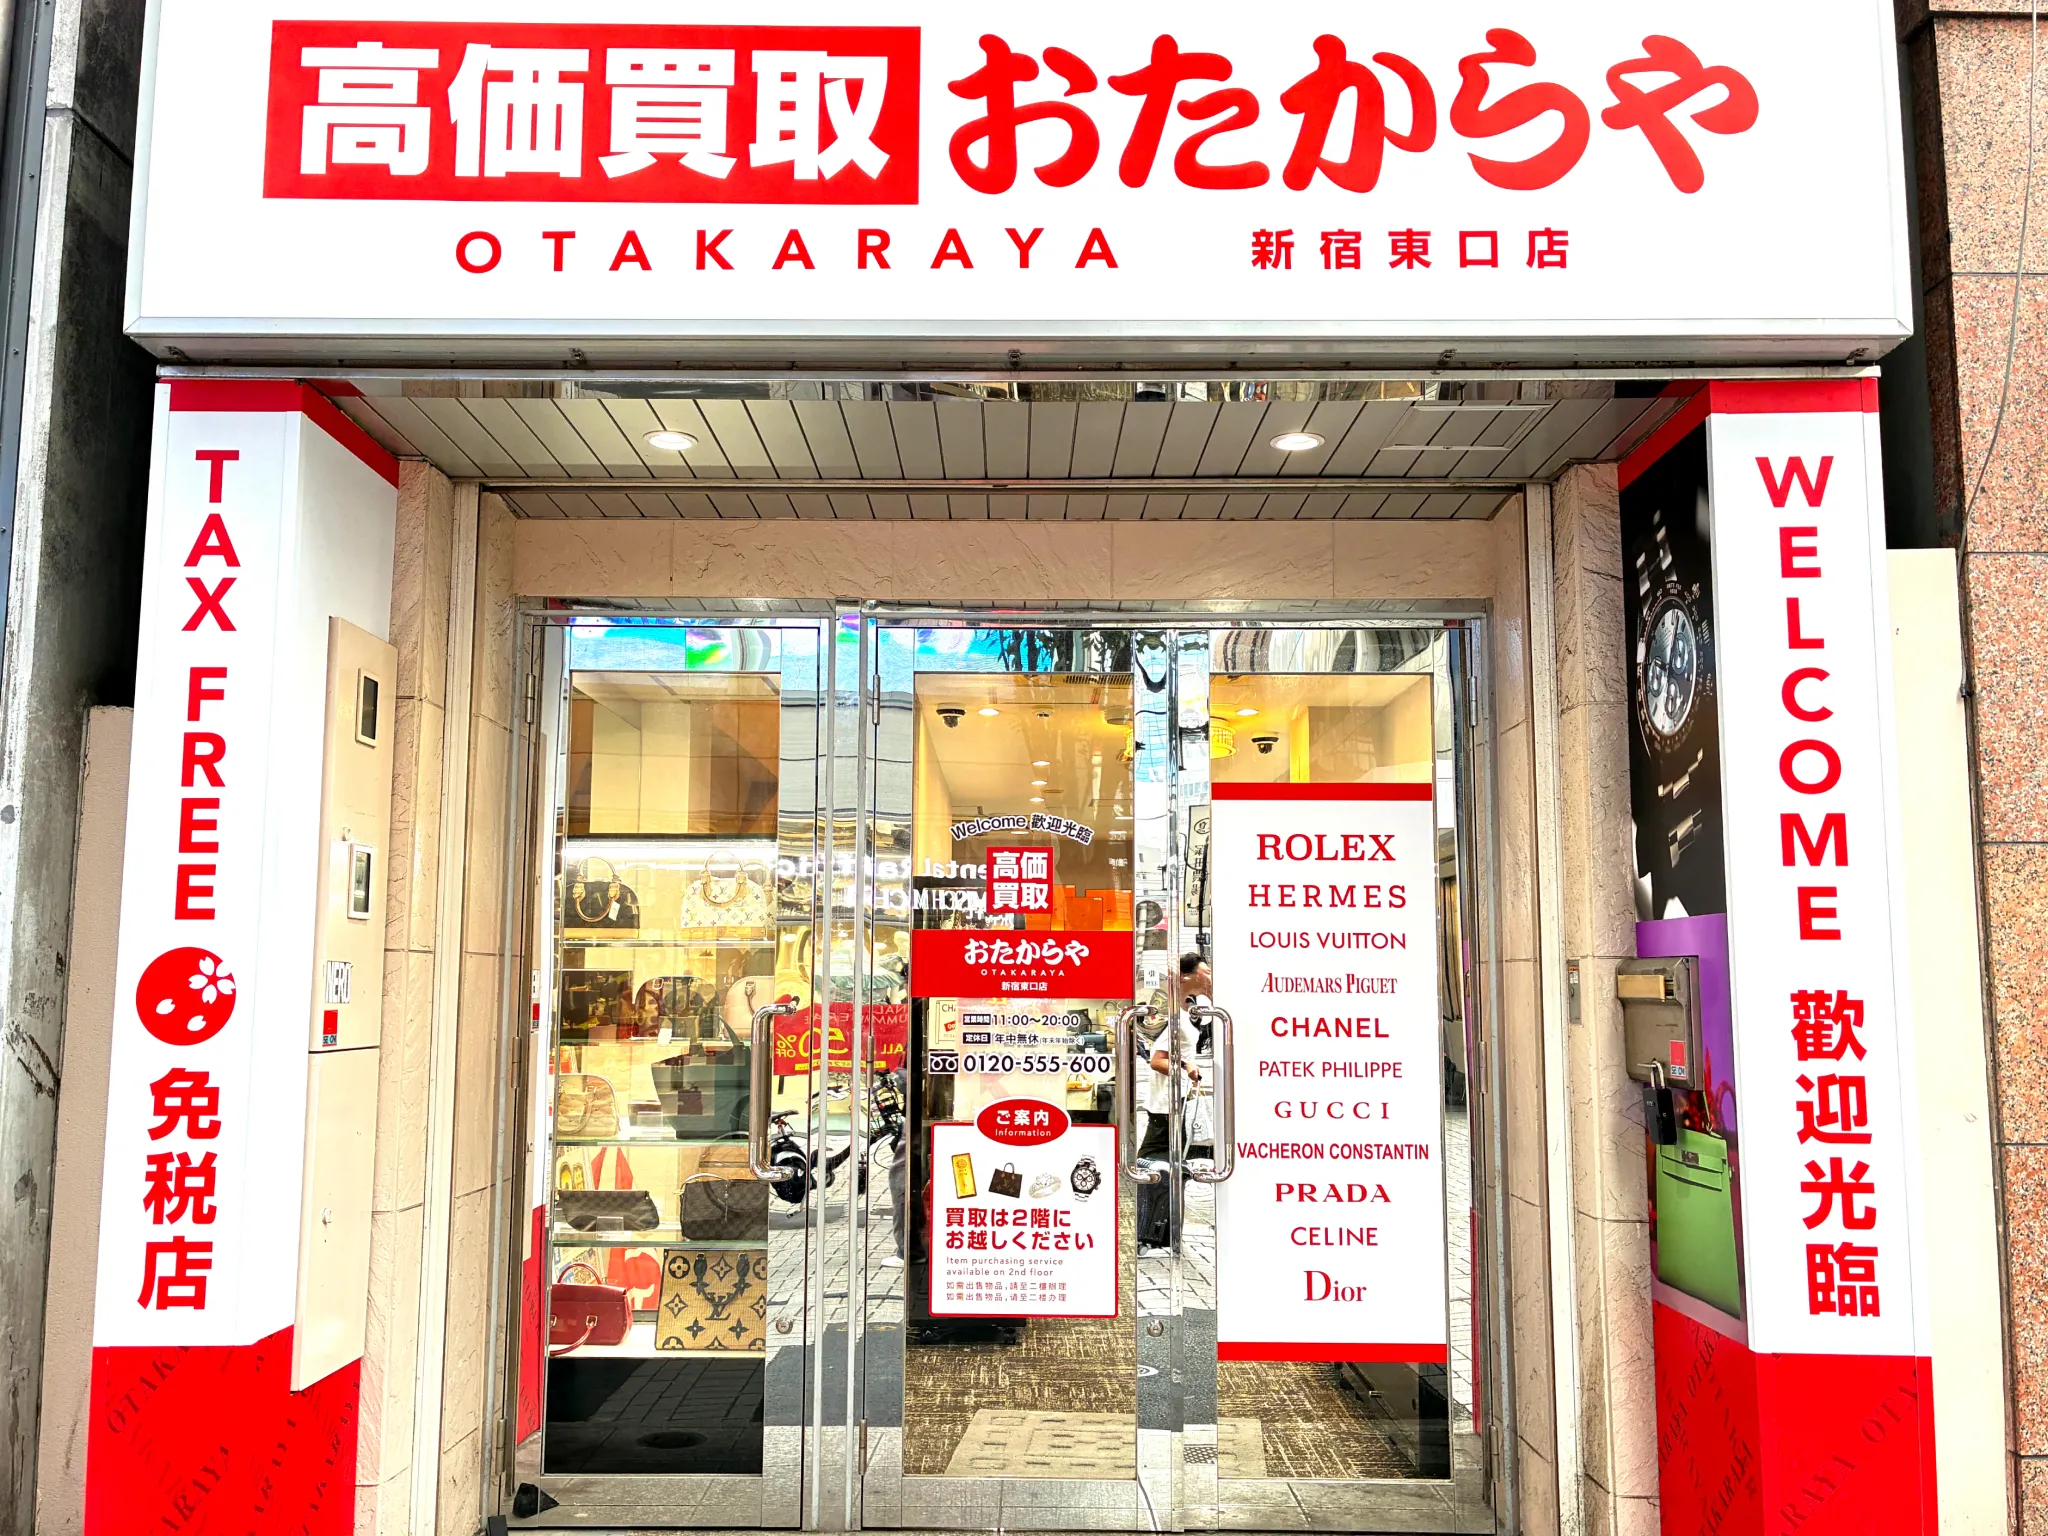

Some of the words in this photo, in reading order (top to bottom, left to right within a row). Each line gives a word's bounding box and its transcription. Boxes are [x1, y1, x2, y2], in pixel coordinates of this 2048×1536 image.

[301, 42, 889, 179] 高価買取
[948, 28, 1760, 195] おたからや
[456, 228, 1118, 274] OTAKARAYA
[1252, 227, 1569, 271] 新宿東口店
[182, 450, 241, 632] TAX
[1755, 456, 1849, 941] WELCOME
[174, 667, 228, 920] FREE
[951, 815, 1026, 840] Welcome
[1031, 814, 1093, 843] 歡迎光臨
[1256, 833, 1396, 862] ROLEX
[993, 852, 1048, 880] 高価
[993, 883, 1049, 910] 買取
[1248, 883, 1407, 909] HERMES
[1250, 931, 1310, 949] LOUIS
[1316, 932, 1407, 950] VUITTON
[964, 938, 1090, 967] おたからや
[980, 969, 1065, 977] OTAKARAYA
[1261, 973, 1342, 994] AUDEMARS
[1346, 973, 1398, 994] PIGUET
[1001, 980, 1048, 992] 新宿東口店
[1270, 1016, 1390, 1039] CHANEL
[965, 1033, 989, 1043] 定休日
[994, 1033, 1039, 1045] 年中無休
[963, 1054, 1111, 1073] 0120-555-600
[1259, 1060, 1315, 1078] PATEK
[1322, 1061, 1403, 1079] PHILIPPE
[996, 1109, 1050, 1127] ご案内
[1274, 1101, 1390, 1120] GUCCI
[995, 1128, 1052, 1137] Information
[1237, 1142, 1325, 1159] VACHERON
[1329, 1143, 1429, 1160] CONSTANTIN
[1790, 989, 1881, 1318] 歡迎光臨
[137, 1068, 222, 1311] 免税店
[1275, 1183, 1392, 1203] PRADA
[945, 1207, 1071, 1229] 買取は2階に
[945, 1230, 1094, 1251] お越しください
[1290, 1226, 1378, 1247] CELINE
[946, 1267, 990, 1276] available
[1008, 1267, 1026, 1276] 2nd
[1029, 1267, 1054, 1276] floor
[971, 1256, 1025, 1266] purchasing
[1028, 1257, 1063, 1265] service
[1303, 1270, 1367, 1302] Dior
